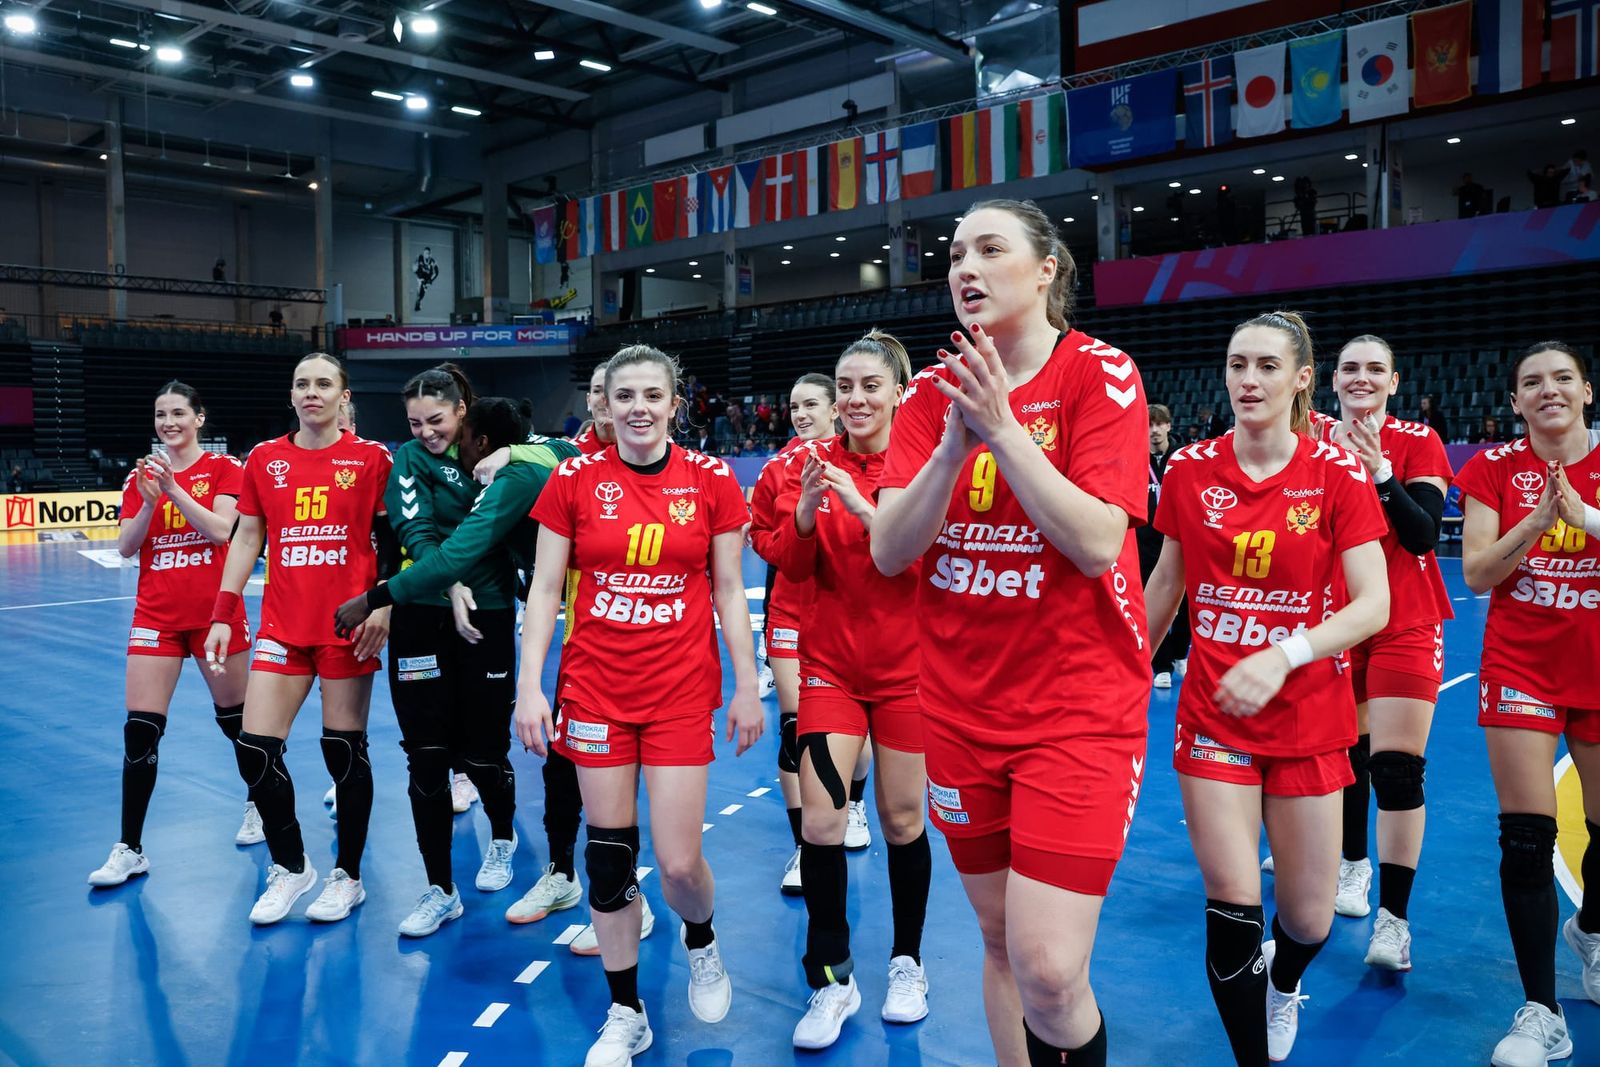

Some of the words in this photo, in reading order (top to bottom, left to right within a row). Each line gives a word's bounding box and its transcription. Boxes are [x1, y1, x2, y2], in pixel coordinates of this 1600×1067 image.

[889, 226, 902, 239] M
[725, 254, 735, 265] N
[366, 331, 437, 343] HANDS
[440, 331, 468, 342] UP
[472, 331, 512, 341] FOR
[517, 330, 569, 341] MORE
[969, 451, 998, 513] 9
[294, 485, 330, 521] 55
[281, 524, 349, 537] BEMAX
[280, 545, 348, 567] SBbet
[625, 523, 665, 566] 10
[1231, 529, 1276, 579] 13
[1520, 555, 1600, 571] EMA
[929, 553, 1045, 599] SBbet
[1197, 582, 1313, 605] BEMAX
[589, 591, 686, 625] SBbet
